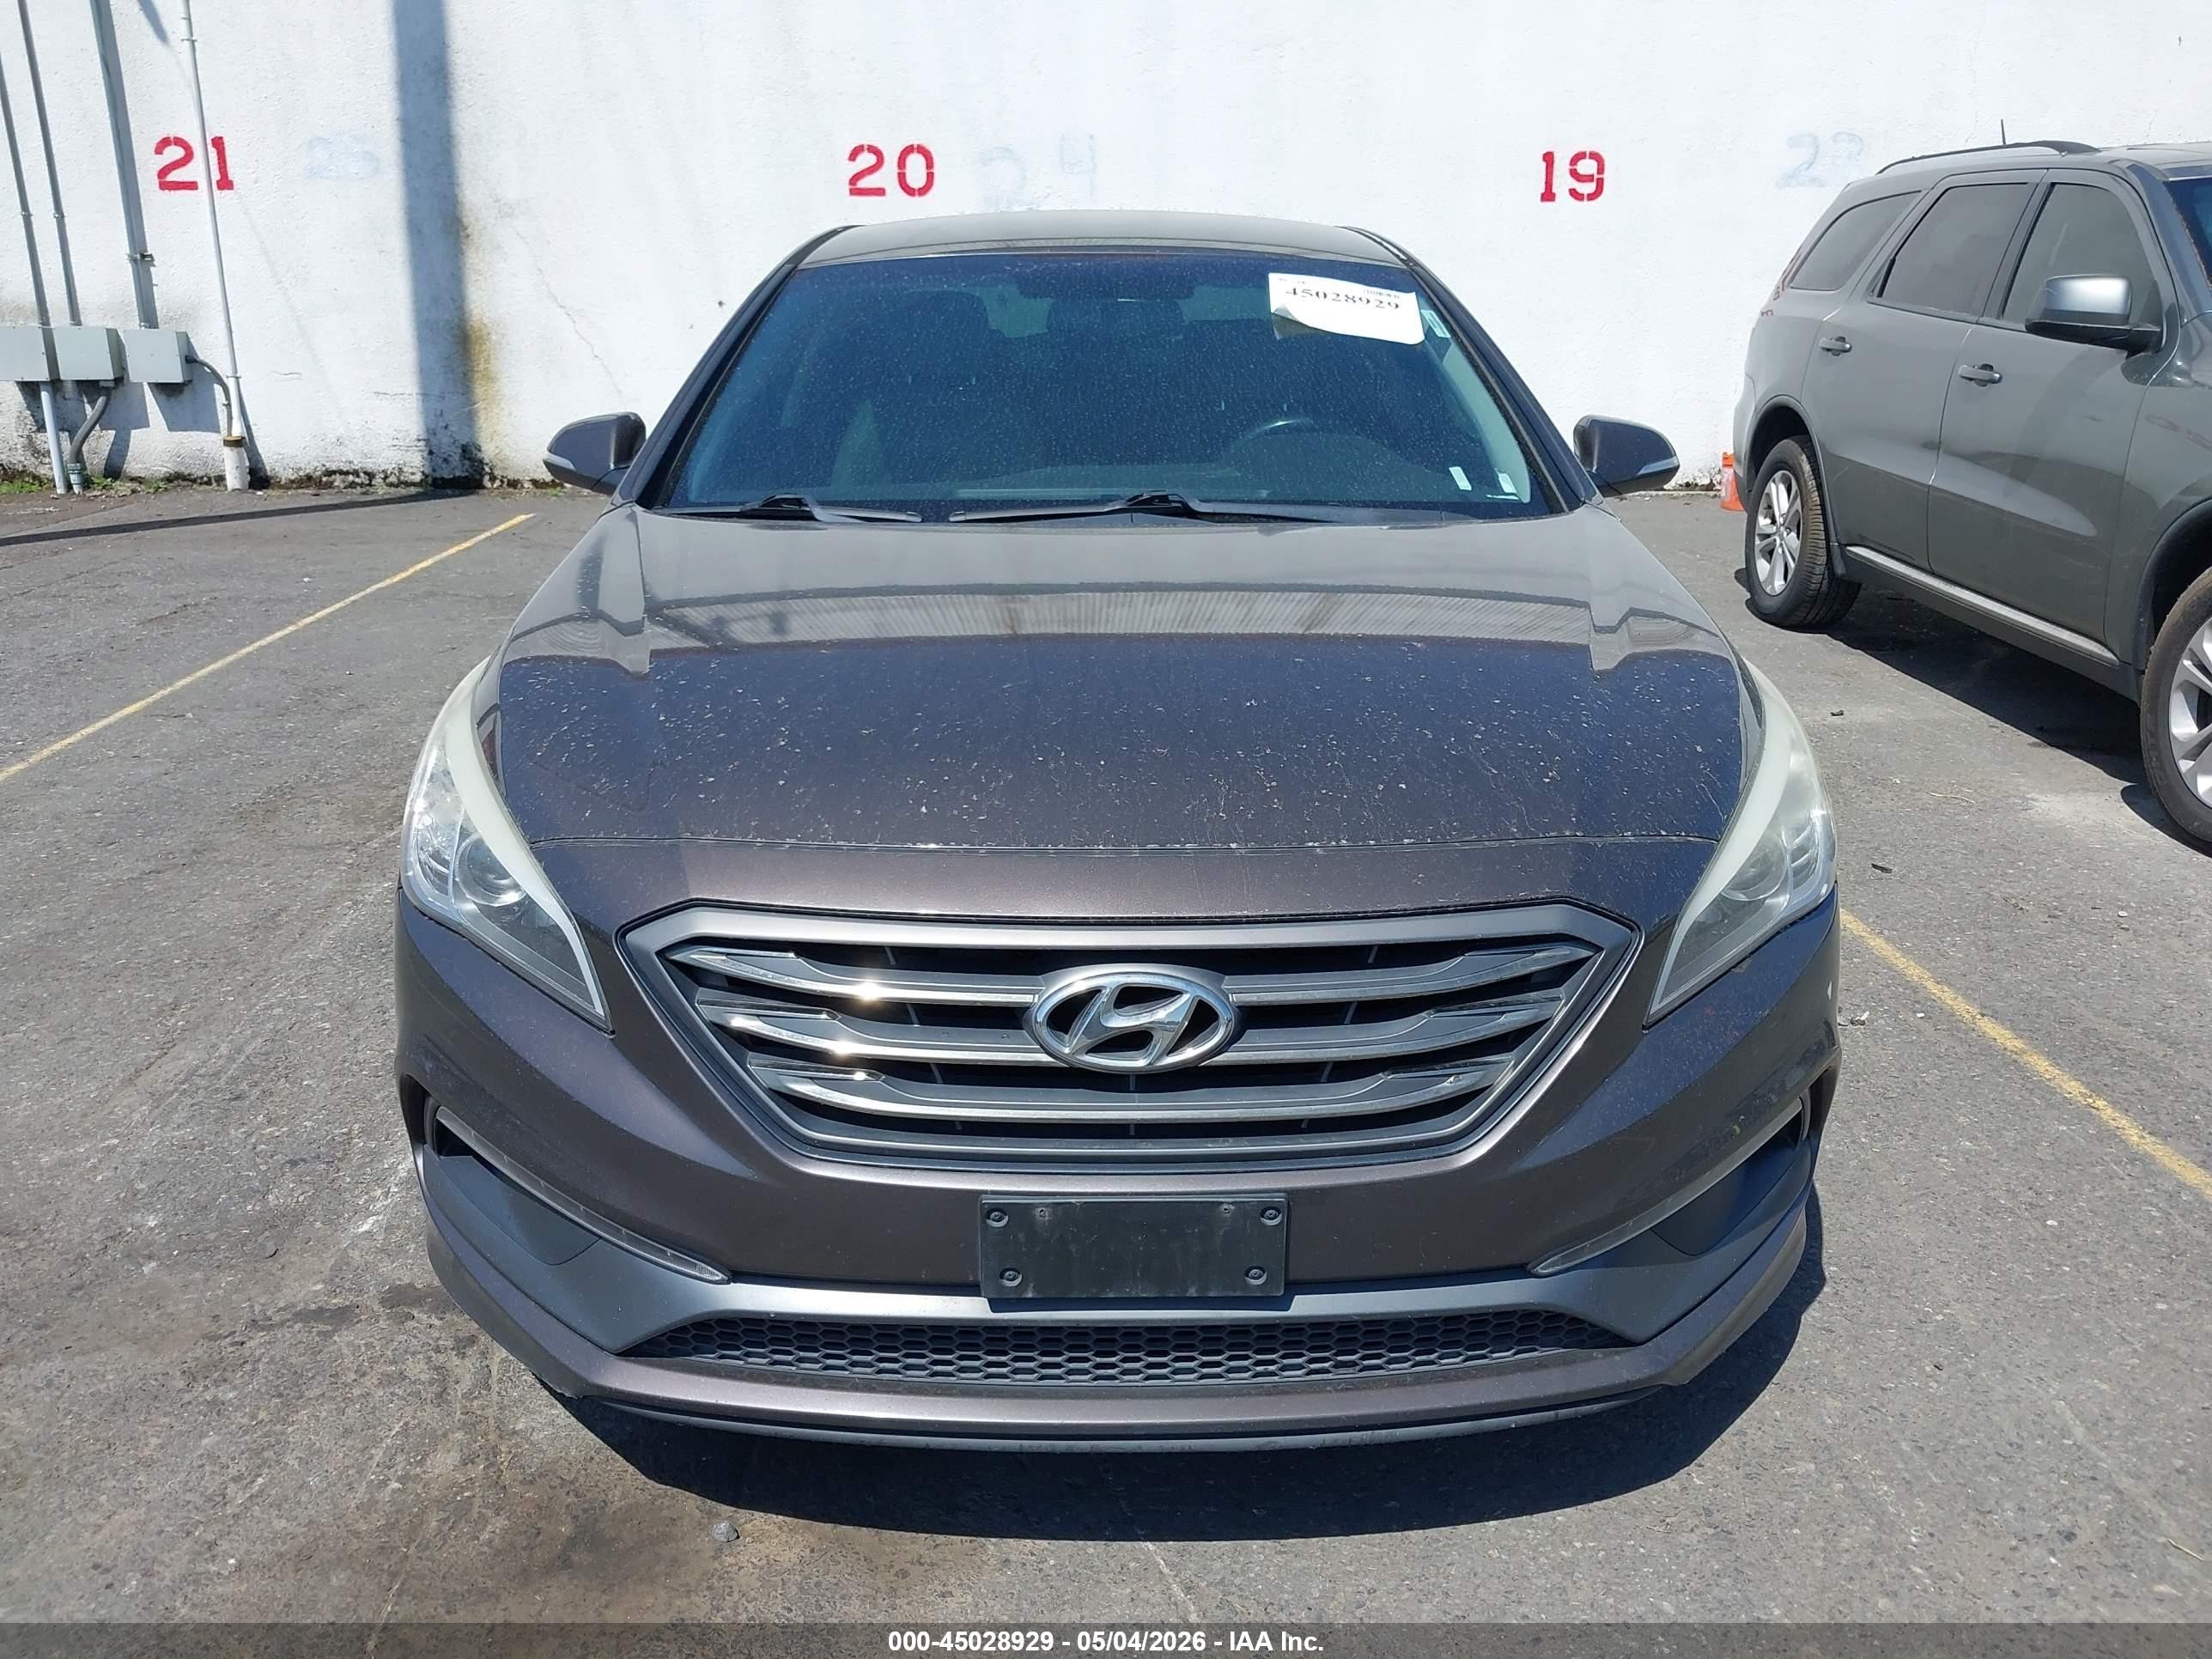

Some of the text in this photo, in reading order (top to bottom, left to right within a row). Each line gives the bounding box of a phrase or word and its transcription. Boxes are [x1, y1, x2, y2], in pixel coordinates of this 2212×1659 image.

[155, 137, 234, 191] 21
[848, 144, 935, 197] 20
[1540, 151, 1605, 203] 19
[1285, 287, 1400, 310] 45028929
